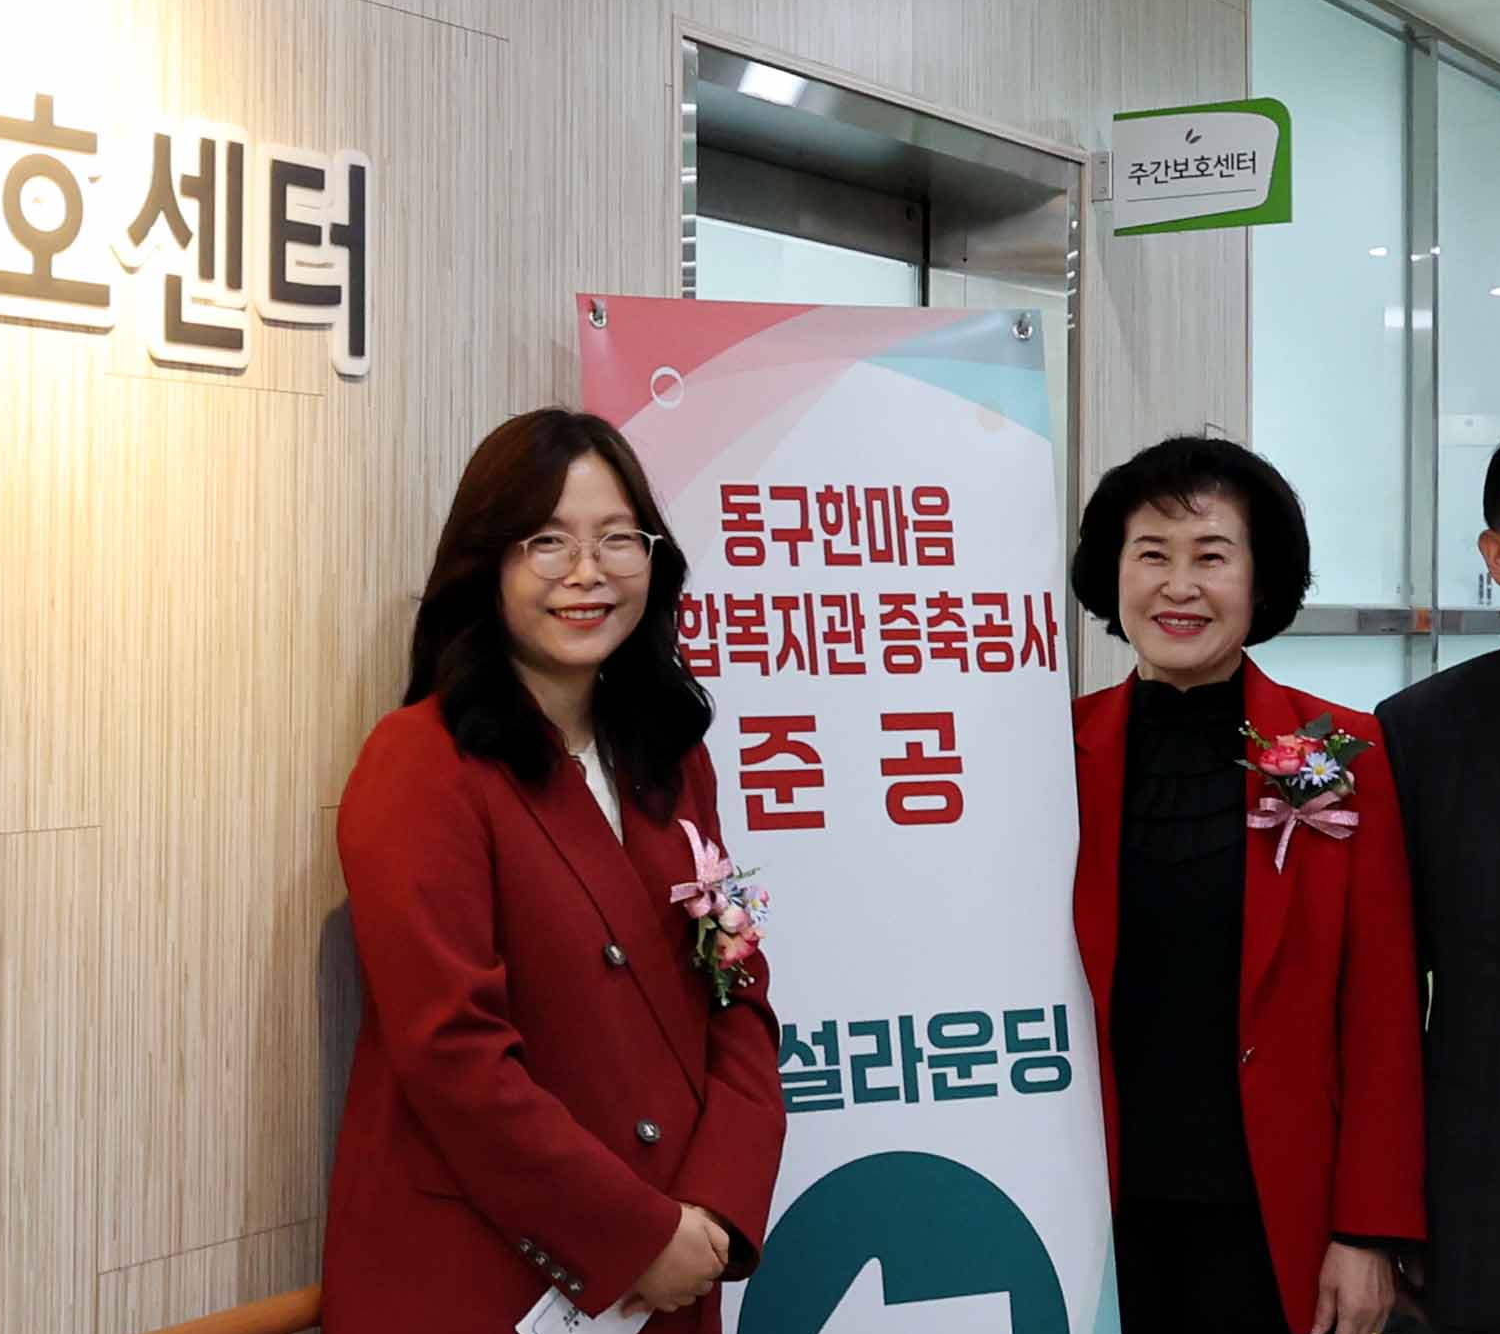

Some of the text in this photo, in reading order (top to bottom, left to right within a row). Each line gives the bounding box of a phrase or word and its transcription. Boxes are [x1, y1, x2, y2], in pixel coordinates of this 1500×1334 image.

[1127, 150, 1257, 186] 주간보호센터
[719, 483, 956, 568] 동구한마음
[678, 590, 1058, 678] 합복지관 증축공사
[778, 1003, 1074, 1114] 설라운딩
